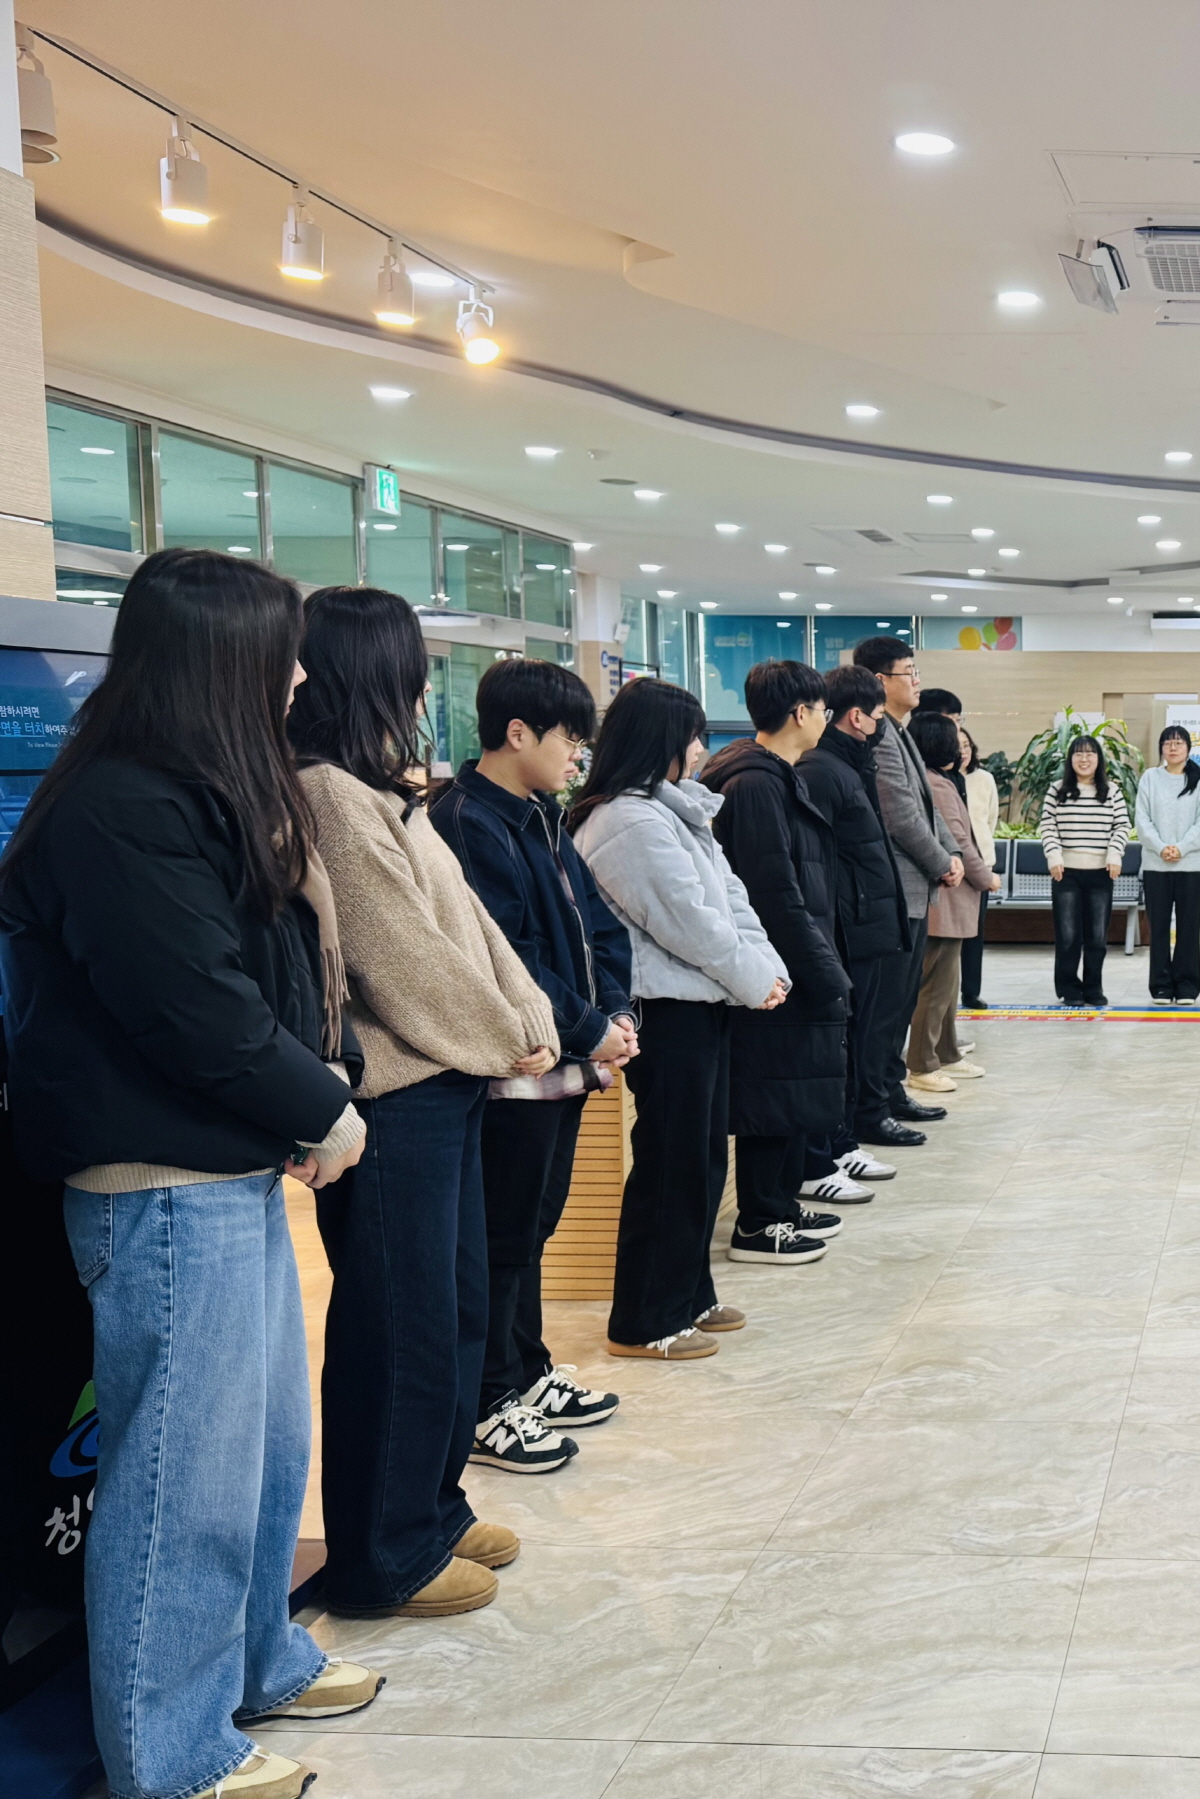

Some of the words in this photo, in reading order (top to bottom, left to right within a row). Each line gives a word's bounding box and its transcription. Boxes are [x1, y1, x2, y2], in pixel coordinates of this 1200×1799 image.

[0, 721, 22, 736] 면을
[484, 1426, 518, 1455] N
[44, 1487, 95, 1555] 청
